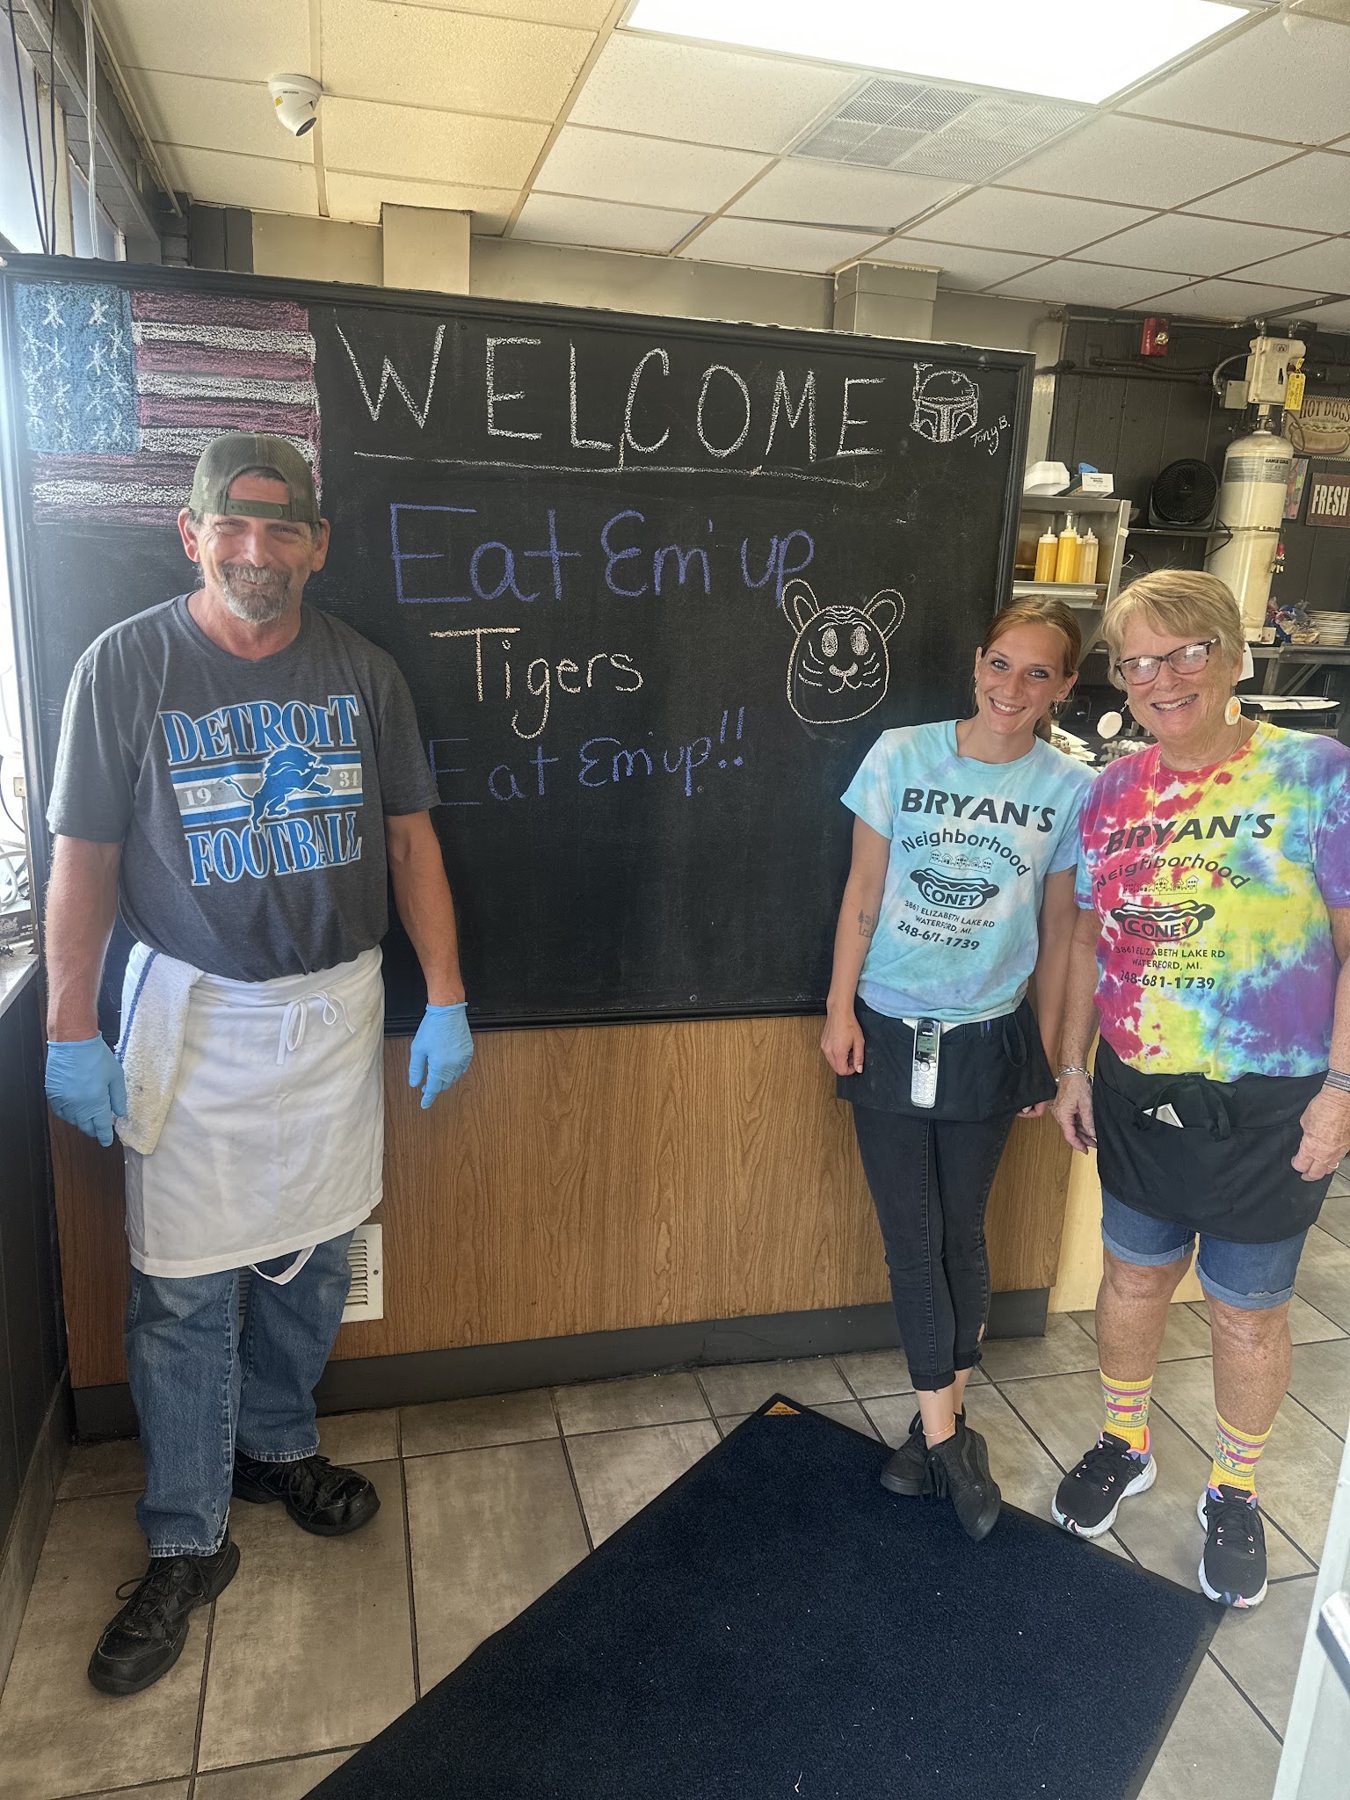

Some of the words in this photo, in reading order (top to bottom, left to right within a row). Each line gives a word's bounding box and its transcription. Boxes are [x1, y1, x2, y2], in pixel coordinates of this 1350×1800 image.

[336, 322, 886, 463] WELCOME
[1299, 399, 1323, 418] HOT
[970, 426, 999, 455] Tony
[998, 415, 1010, 429] B.
[1311, 485, 1350, 516] FRESH
[390, 503, 582, 603] Eat
[740, 529, 814, 608] up
[429, 627, 644, 739] Tigers
[158, 695, 360, 766] DETROIT
[429, 738, 560, 806] Eat
[184, 787, 212, 806] 19
[901, 788, 1056, 833] BRYAN'S
[184, 811, 363, 886] FOOTBALL
[901, 828, 1031, 877] Neighborhood
[1106, 814, 1275, 856] BRYAN'S
[1096, 854, 1251, 892] Neighborhood
[923, 882, 980, 907] CONEY
[920, 907, 960, 923] ELIZABETH
[961, 918, 982, 927] LAKE
[982, 920, 995, 928] RD
[1127, 918, 1194, 939] CONEY
[1135, 947, 1178, 958] ELIZABETH
[1181, 949, 1208, 958] LAKE
[1210, 949, 1226, 958] RD
